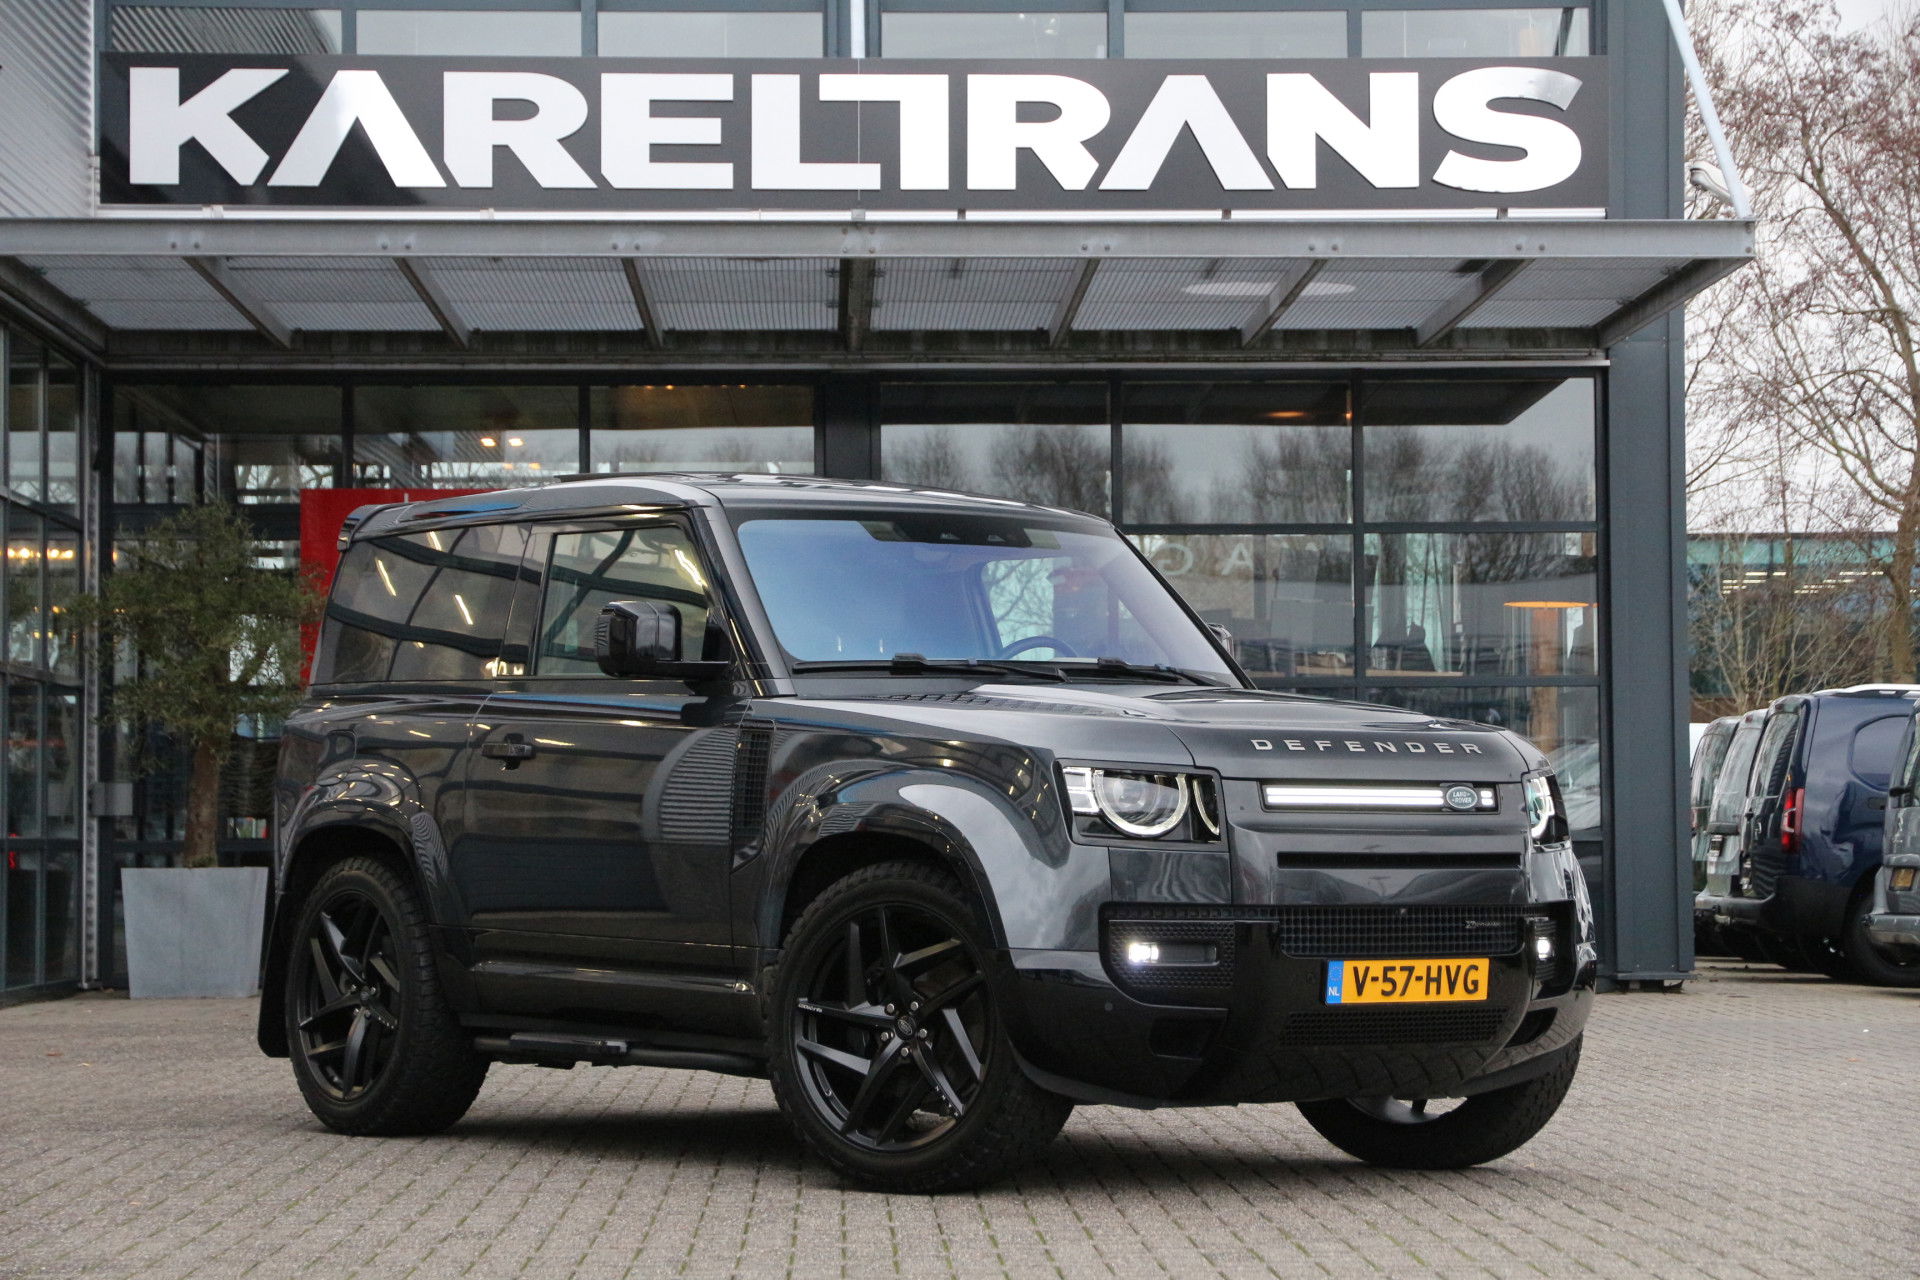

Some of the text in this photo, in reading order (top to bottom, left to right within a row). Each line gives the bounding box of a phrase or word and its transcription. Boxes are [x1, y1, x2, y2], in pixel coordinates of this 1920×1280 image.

[1250, 739, 1482, 754] DEFENDER
[1353, 964, 1479, 997] V-57-HVG
[1328, 986, 1340, 996] NL
